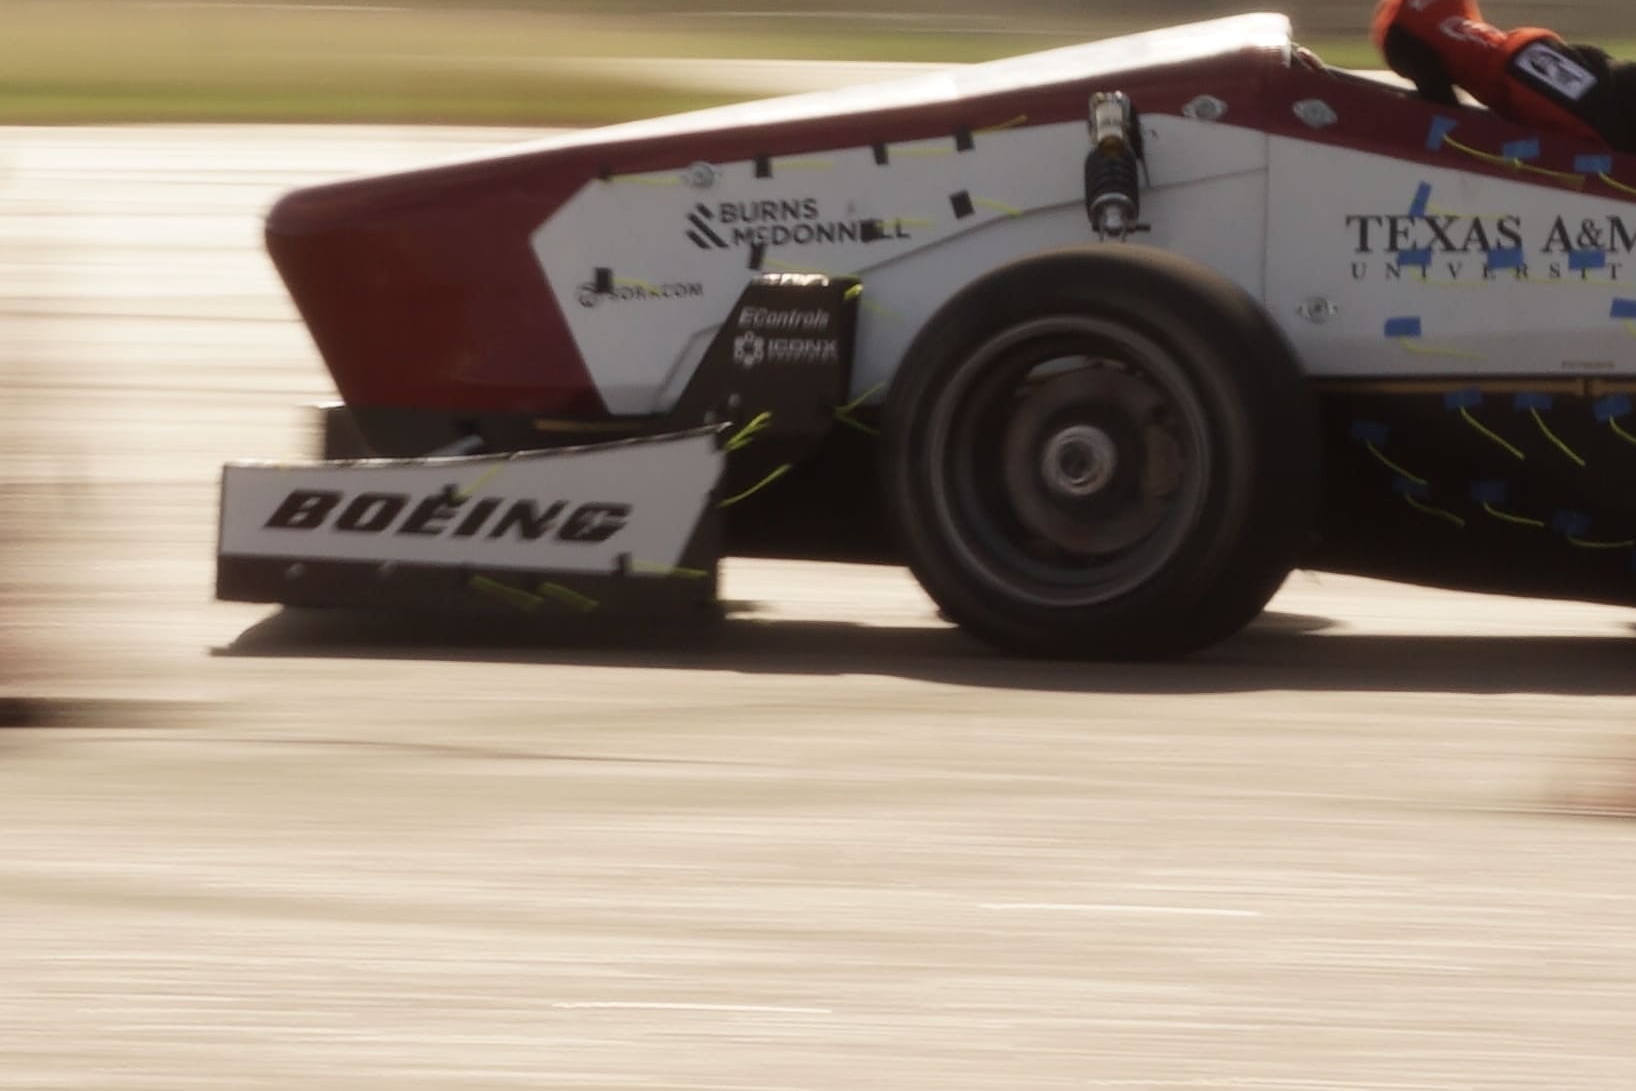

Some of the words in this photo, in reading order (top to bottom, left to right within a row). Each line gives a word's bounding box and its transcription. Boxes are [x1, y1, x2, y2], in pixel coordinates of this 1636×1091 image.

[719, 199, 819, 224] BURNS
[1346, 215, 1522, 254] TEXAS
[263, 488, 634, 542] BOEING
